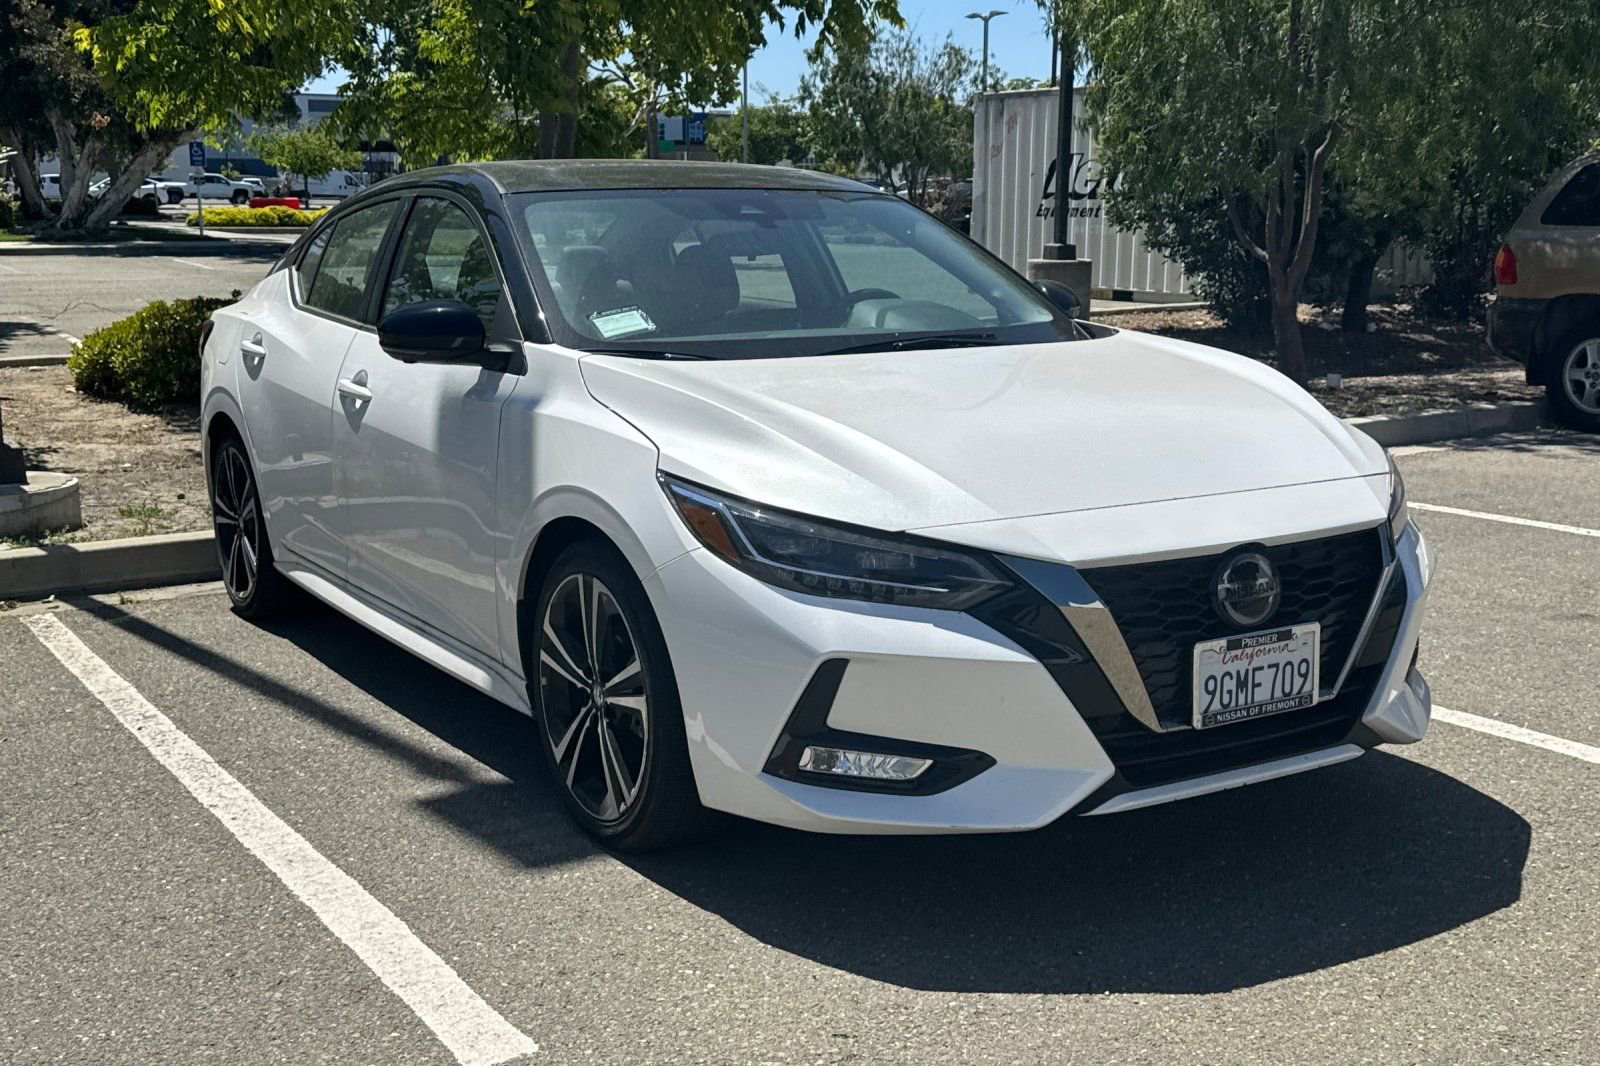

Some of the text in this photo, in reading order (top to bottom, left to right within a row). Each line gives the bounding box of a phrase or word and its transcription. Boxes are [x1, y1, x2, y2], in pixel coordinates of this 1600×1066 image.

[1036, 203, 1101, 221] Eqment
[1241, 633, 1278, 648] PREMIER
[1222, 642, 1297, 666] California
[1203, 658, 1310, 714] 9GMF709
[1217, 698, 1300, 722] NISSAN OF FREMONT
